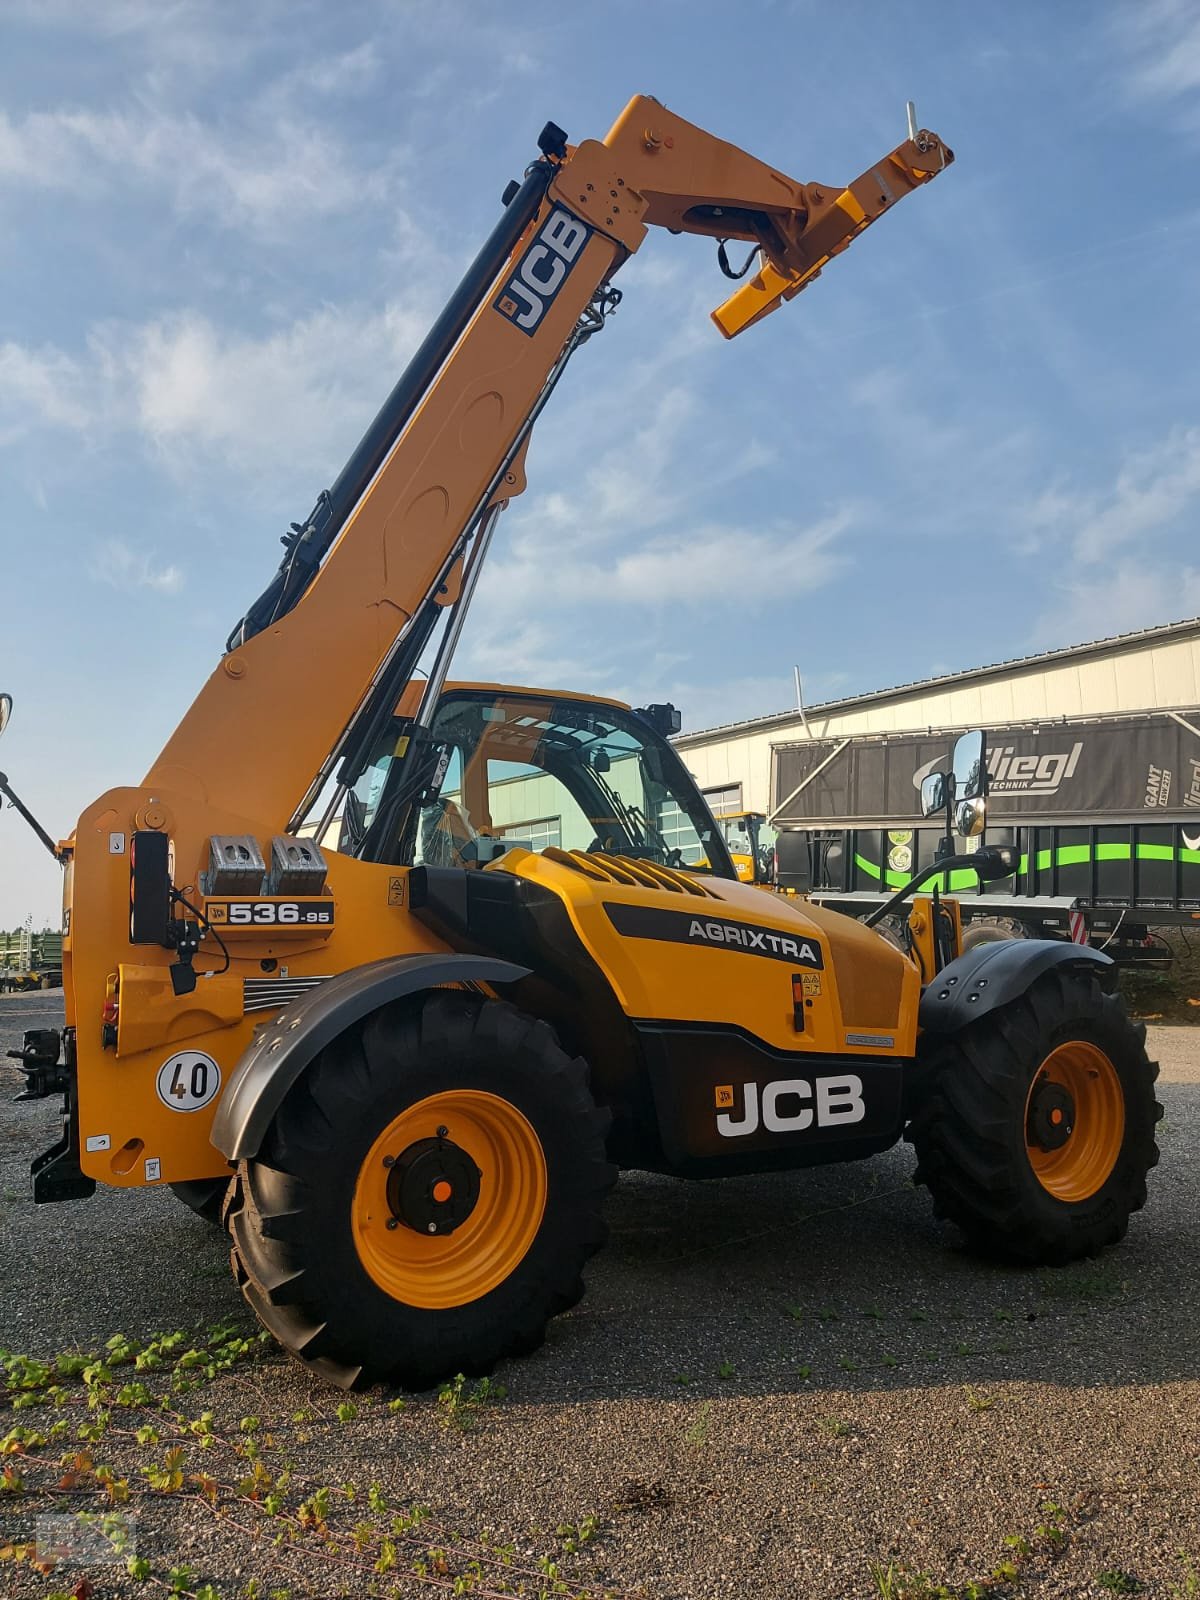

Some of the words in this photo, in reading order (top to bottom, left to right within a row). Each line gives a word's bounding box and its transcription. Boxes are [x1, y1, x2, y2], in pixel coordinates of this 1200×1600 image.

[510, 209, 587, 328] JCB
[985, 742, 1083, 788] liegl
[688, 920, 817, 962] AGRIXTRA
[170, 1062, 208, 1100] 40
[716, 1074, 866, 1137] JCB
